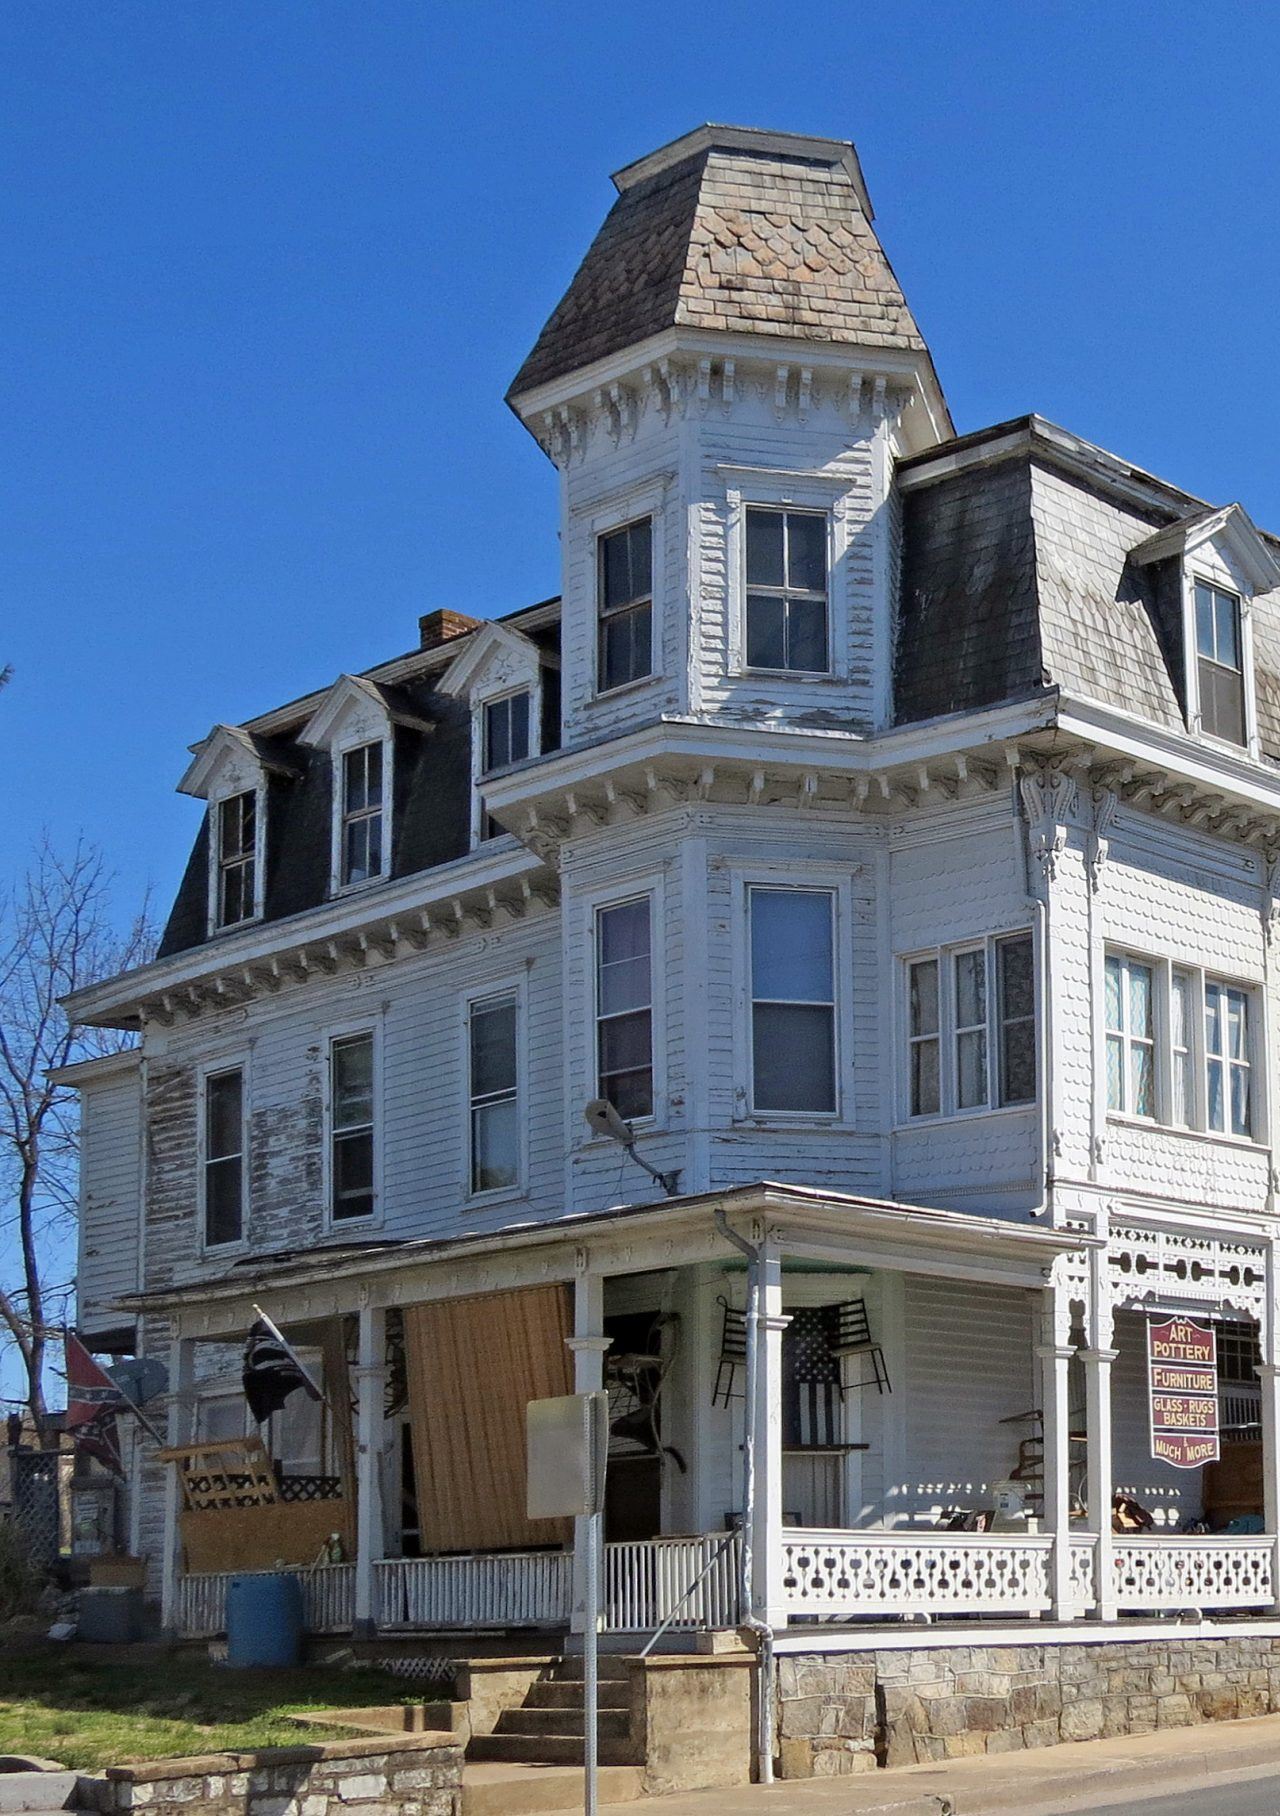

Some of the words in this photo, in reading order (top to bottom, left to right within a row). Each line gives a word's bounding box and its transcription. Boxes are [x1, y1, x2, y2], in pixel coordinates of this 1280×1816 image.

[1169, 1324, 1193, 1342] ART
[1153, 1340, 1210, 1360] POTTERY
[1153, 1368, 1213, 1389] FURNITURE
[1154, 1398, 1183, 1412] GLASS
[1189, 1400, 1214, 1414] RUGS
[1164, 1412, 1206, 1427] BASKETS
[1156, 1439, 1182, 1460] MUCH
[1187, 1442, 1215, 1461] MORE
